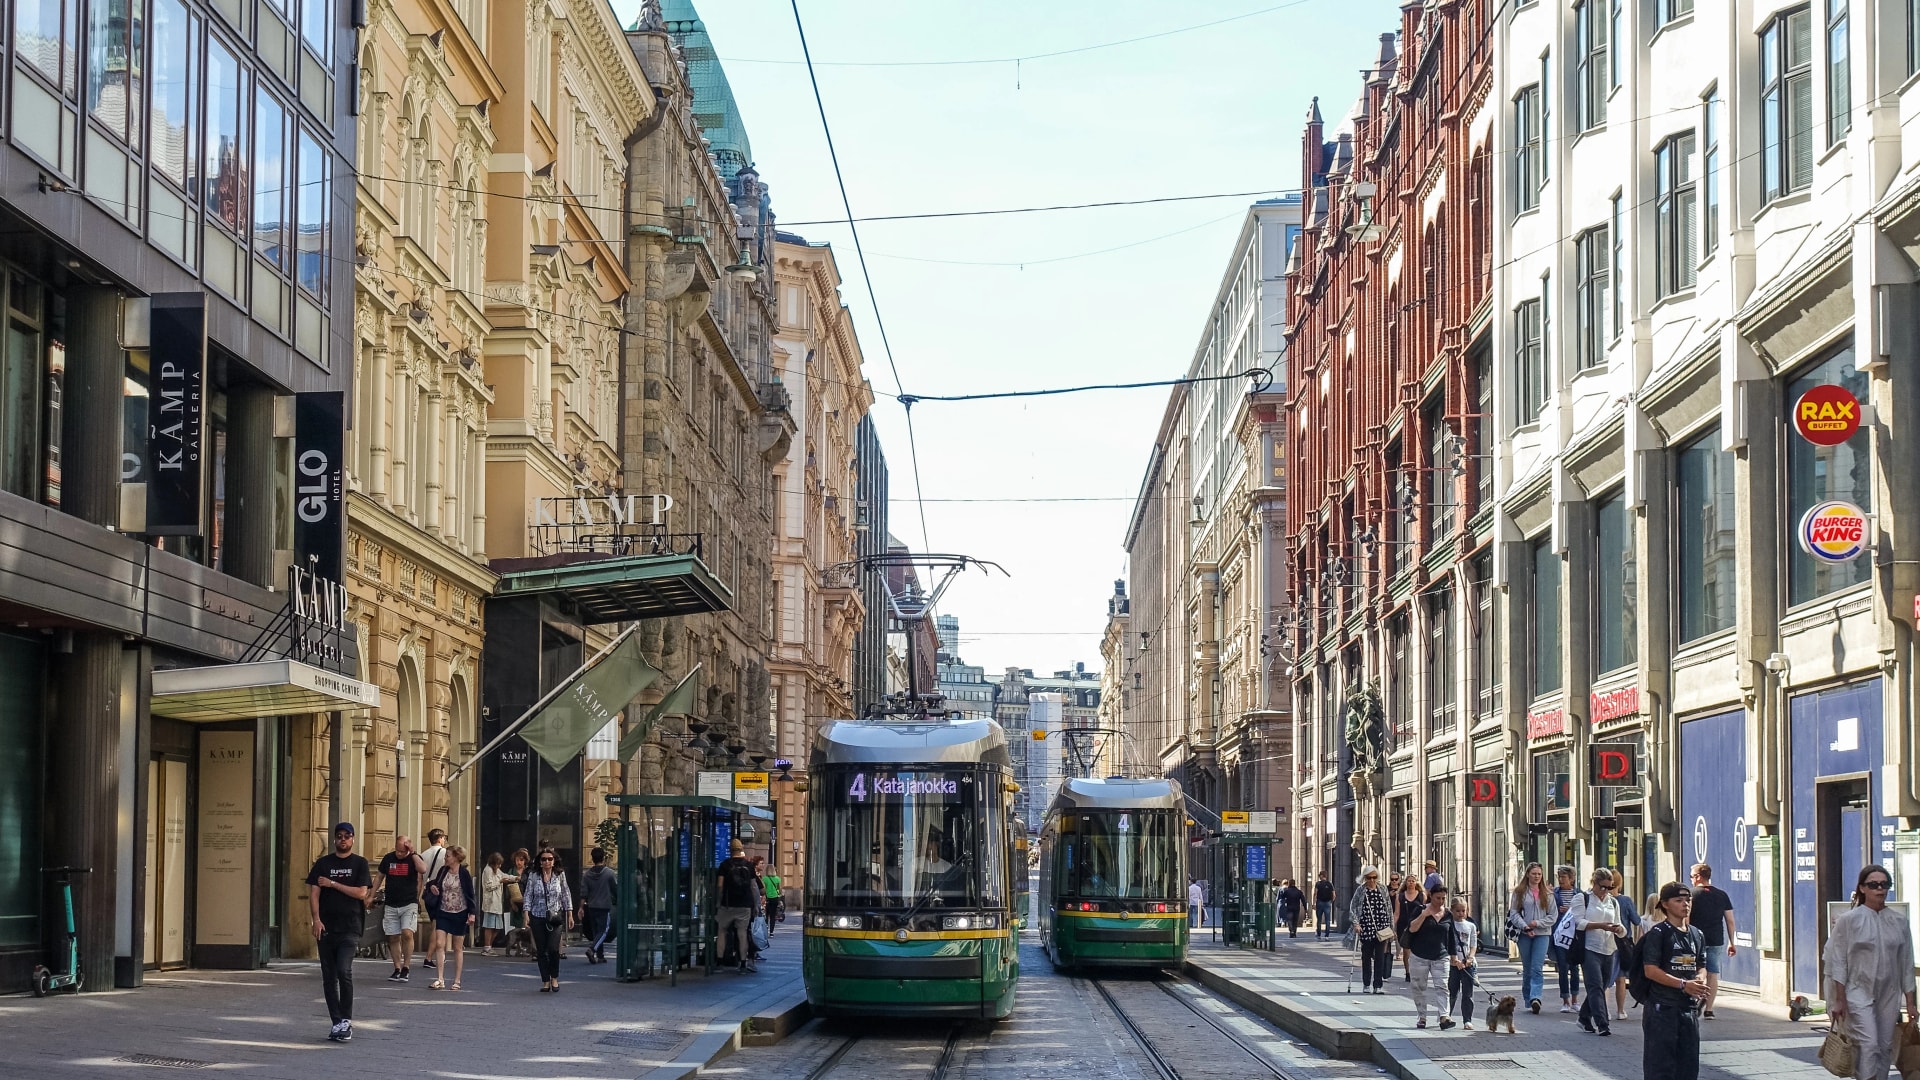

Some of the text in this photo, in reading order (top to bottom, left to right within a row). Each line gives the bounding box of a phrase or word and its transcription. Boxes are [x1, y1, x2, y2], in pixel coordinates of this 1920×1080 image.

[190, 371, 200, 461] GALLERIA
[1802, 401, 1854, 420] RAX
[298, 449, 328, 523] GLO
[333, 469, 341, 501] HOTEL
[1812, 527, 1862, 543] KING
[1814, 517, 1862, 528] BURGER
[300, 635, 345, 664] GALLERIA
[314, 674, 360, 697] SHOPPING CENTRE
[1598, 751, 1629, 779] D
[849, 773, 957, 802] 4 Katajanokka
[1471, 779, 1497, 801] D
[1117, 814, 1129, 832] 4
